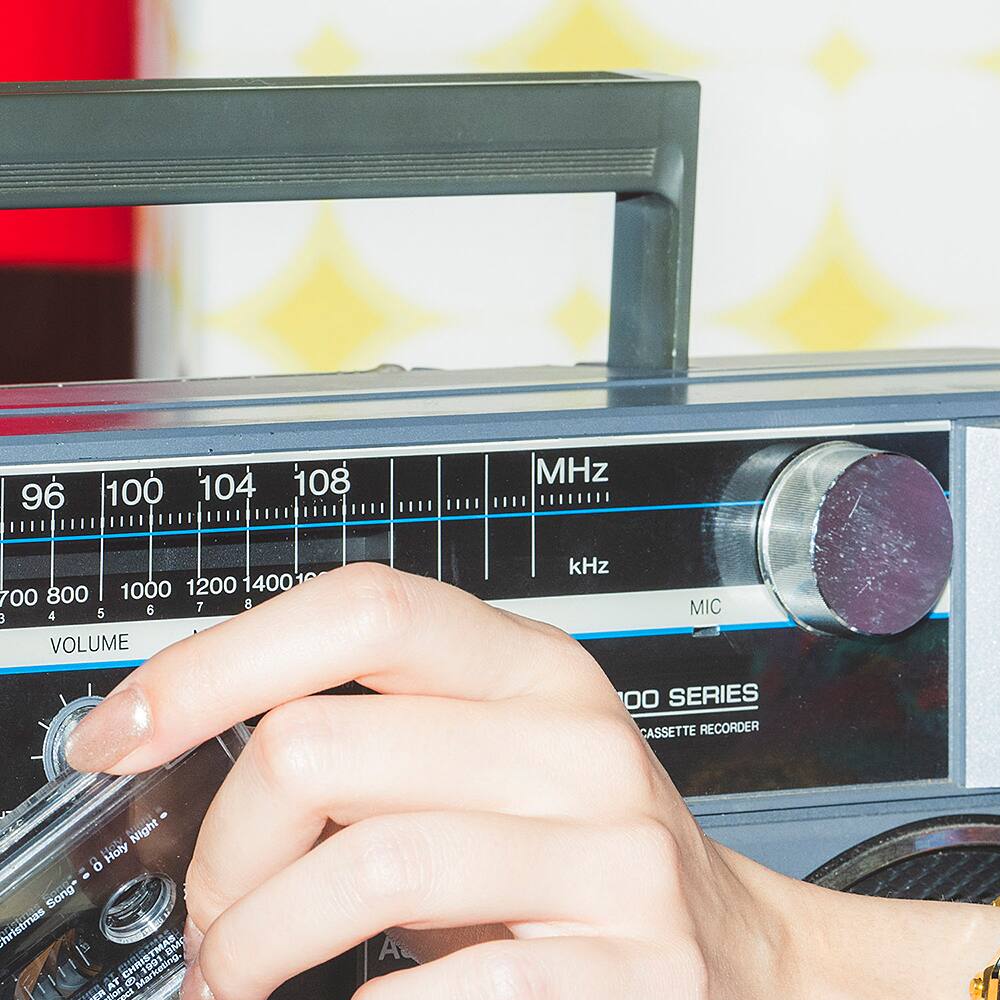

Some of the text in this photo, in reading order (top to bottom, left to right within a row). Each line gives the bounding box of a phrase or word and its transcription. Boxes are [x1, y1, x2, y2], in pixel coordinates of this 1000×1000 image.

[21, 456, 609, 510] 96 100 104 108 MHz
[0, 588, 38, 608] 700
[46, 585, 89, 605] 800
[120, 580, 172, 601] 1000
[186, 576, 237, 597] 1200
[242, 573, 293, 592] 1400
[568, 556, 610, 576] kHz
[48, 610, 56, 622] 4
[97, 607, 105, 619] 5
[146, 604, 154, 616] 6
[196, 601, 204, 613] 7
[244, 598, 252, 610] 8
[690, 598, 722, 616] MIC
[50, 633, 129, 654] VOLUME
[668, 682, 759, 708] SERIES
[640, 720, 760, 740] CASSETTE RECORDER
[104, 842, 129, 863] Holy
[129, 818, 159, 844] Night
[107, 976, 121, 991] AT
[122, 934, 177, 979] CHRISTMAS
[136, 952, 183, 990] Marketing.
[140, 955, 163, 976] 1991
